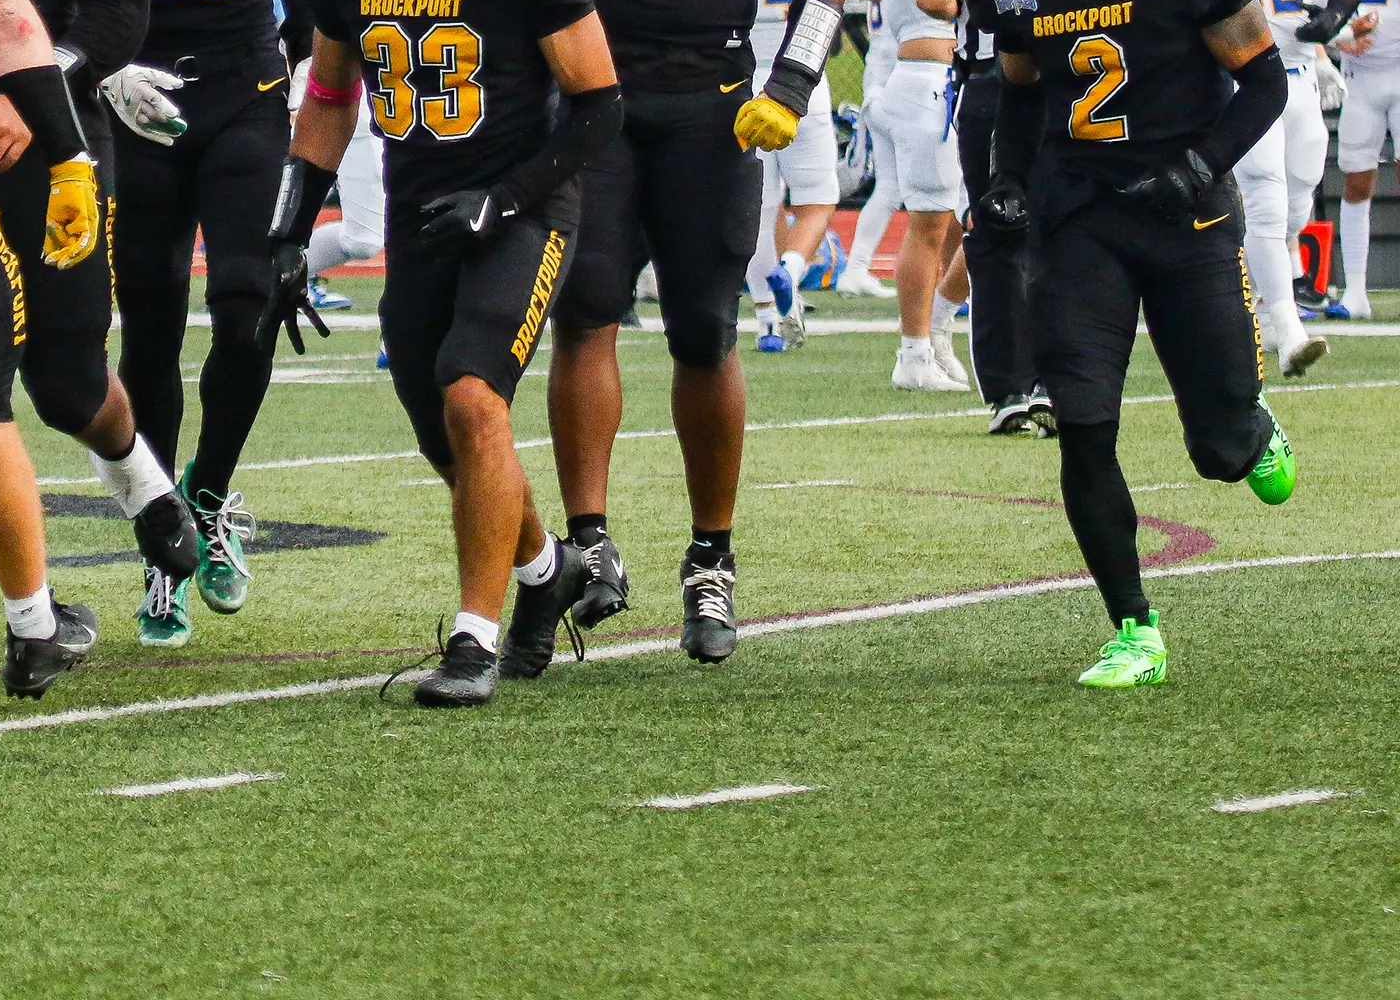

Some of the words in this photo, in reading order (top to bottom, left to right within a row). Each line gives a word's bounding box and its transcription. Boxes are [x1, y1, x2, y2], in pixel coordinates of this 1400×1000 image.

[1032, 0, 1133, 38] BROCKPORT
[359, 20, 487, 142] 33
[1067, 33, 1130, 142] 2
[509, 229, 567, 368] BROCKPORT
